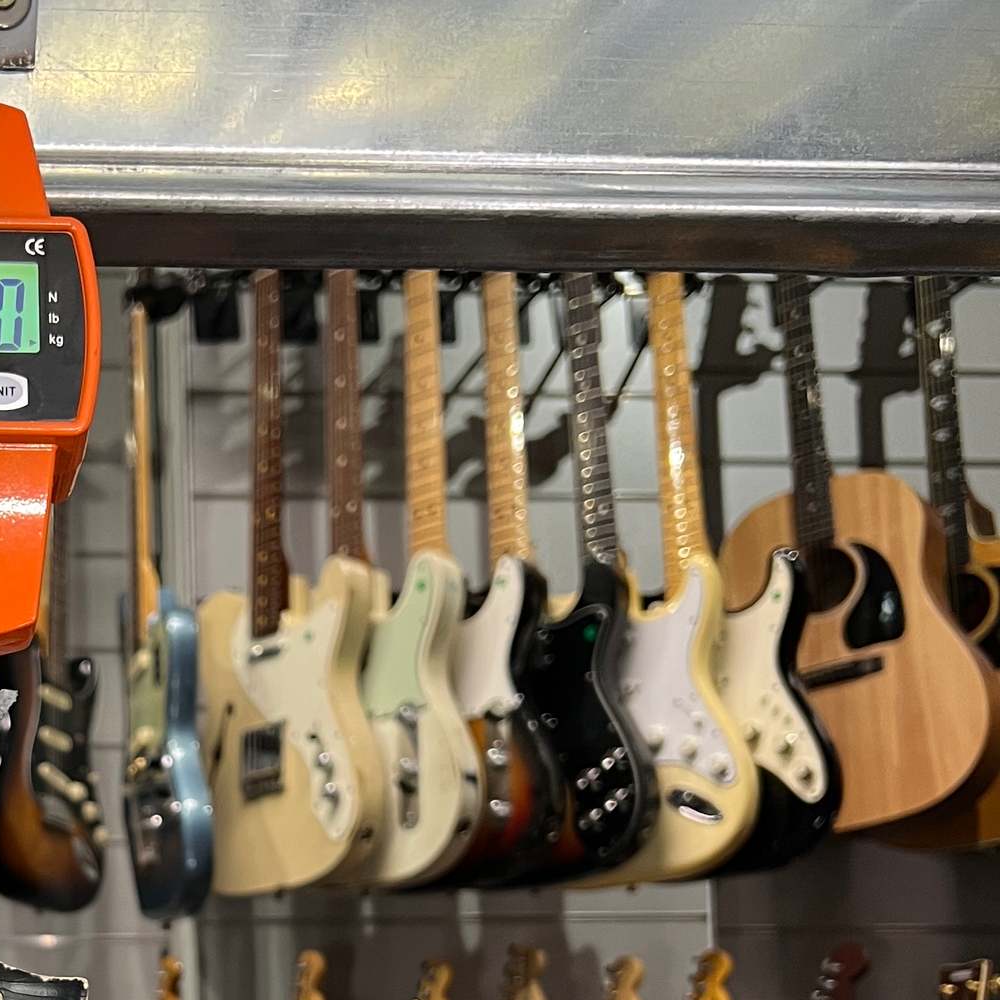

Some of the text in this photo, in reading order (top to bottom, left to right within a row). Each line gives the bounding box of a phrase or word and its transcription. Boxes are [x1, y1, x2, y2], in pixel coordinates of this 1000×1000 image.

[48, 291, 58, 303] N
[48, 312, 60, 324] lb
[49, 334, 64, 347] kg
